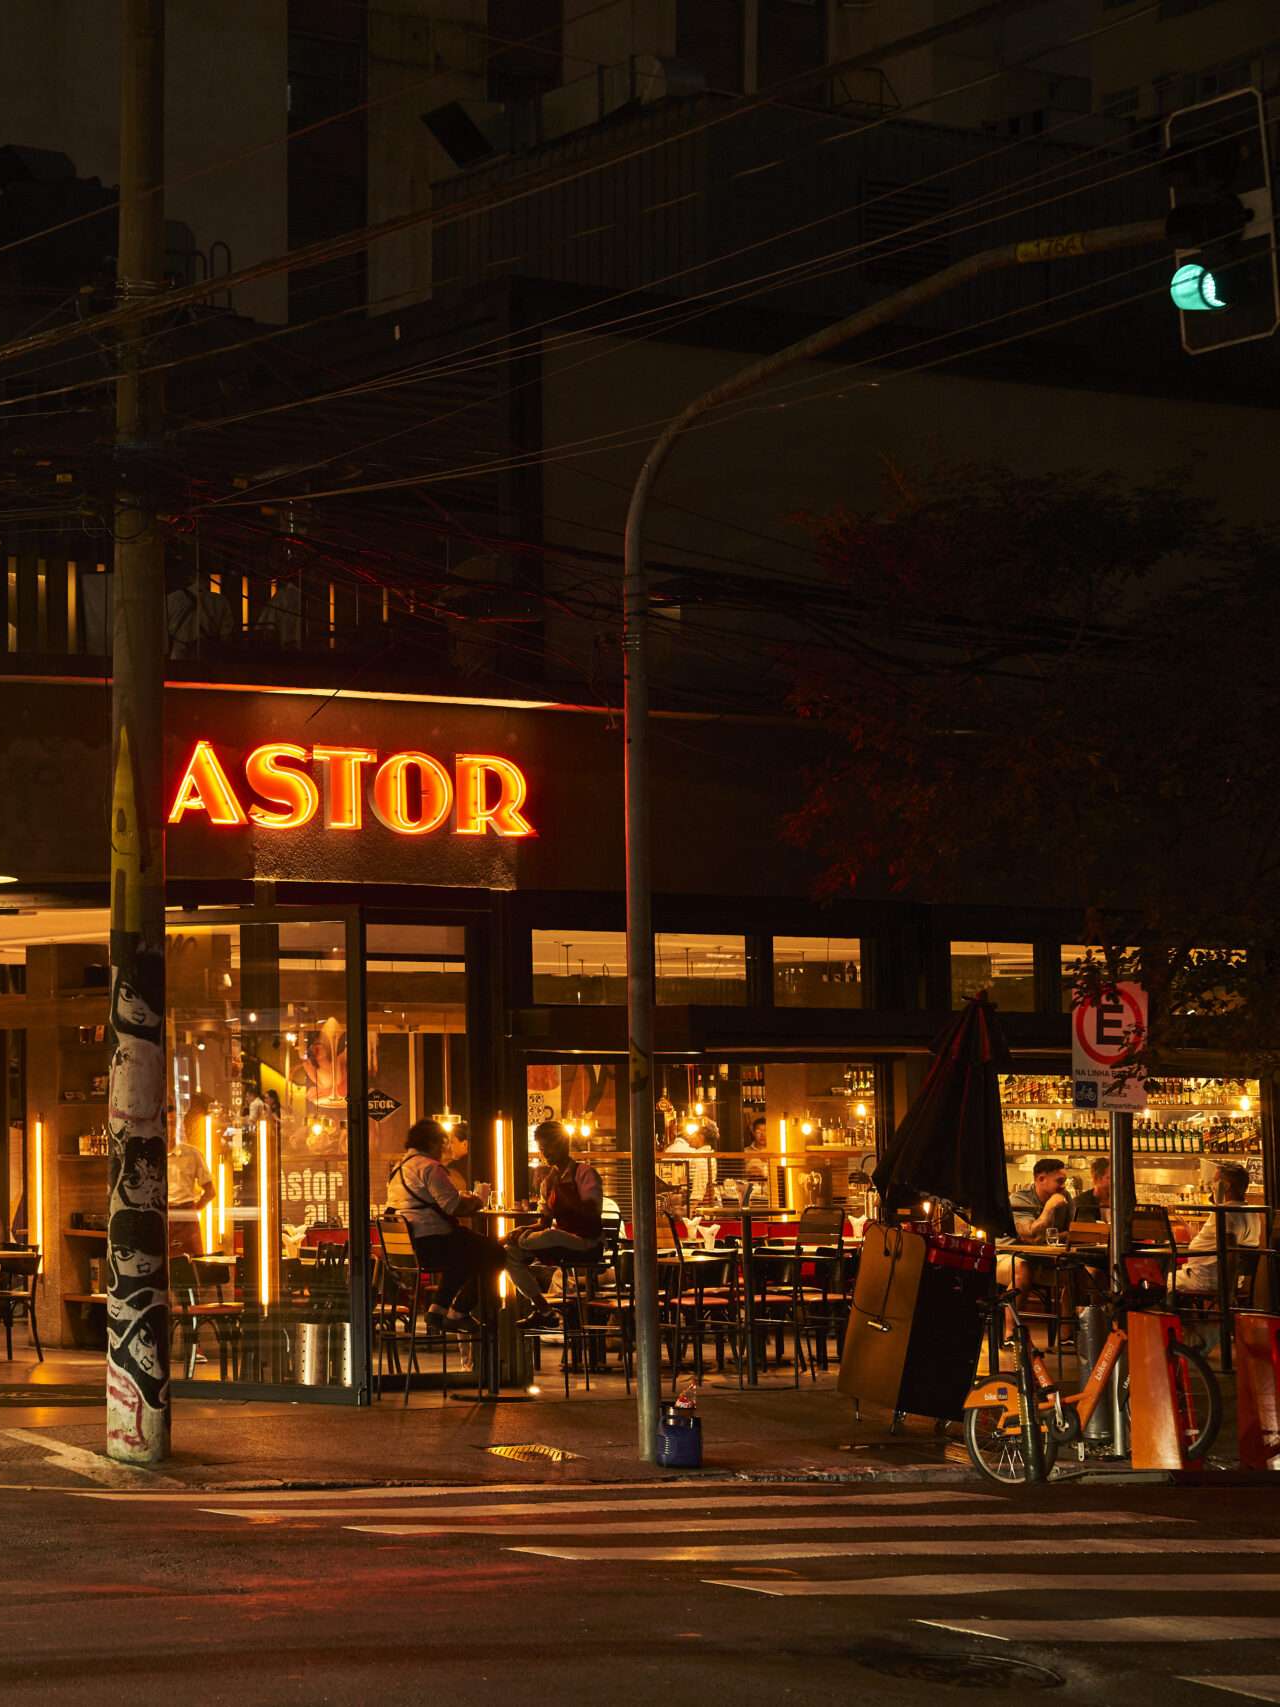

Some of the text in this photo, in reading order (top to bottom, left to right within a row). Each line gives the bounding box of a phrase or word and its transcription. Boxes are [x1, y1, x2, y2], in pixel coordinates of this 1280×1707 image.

[168, 740, 539, 837] ASTOR
[1097, 1004, 1124, 1045] E
[368, 1099, 396, 1110] STOR
